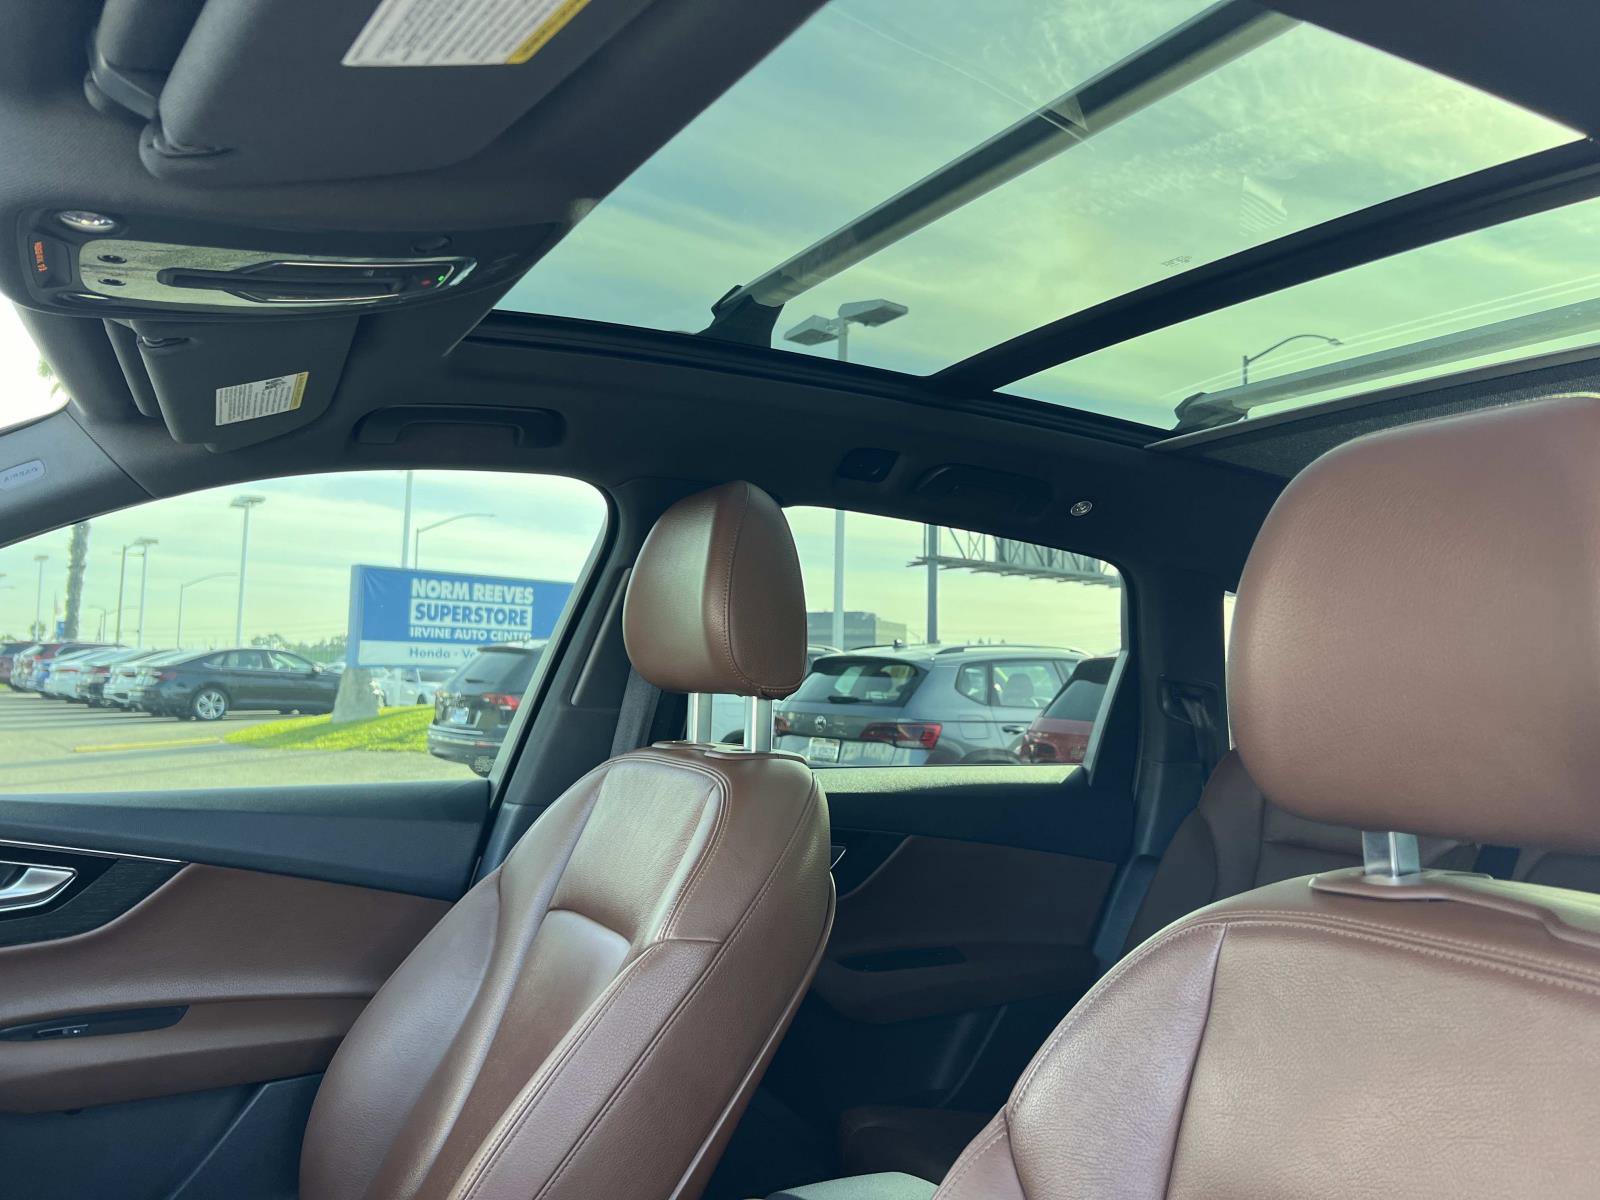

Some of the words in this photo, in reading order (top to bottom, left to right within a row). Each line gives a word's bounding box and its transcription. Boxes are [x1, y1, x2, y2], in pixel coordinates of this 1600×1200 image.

[411, 578, 470, 601] NORM
[473, 583, 534, 604] REEVES
[415, 603, 528, 626] SUPERSTORE
[409, 626, 452, 639] IRVINE
[454, 629, 488, 641] AUTO
[490, 630, 532, 643] CENTER
[409, 647, 451, 659] Honda
